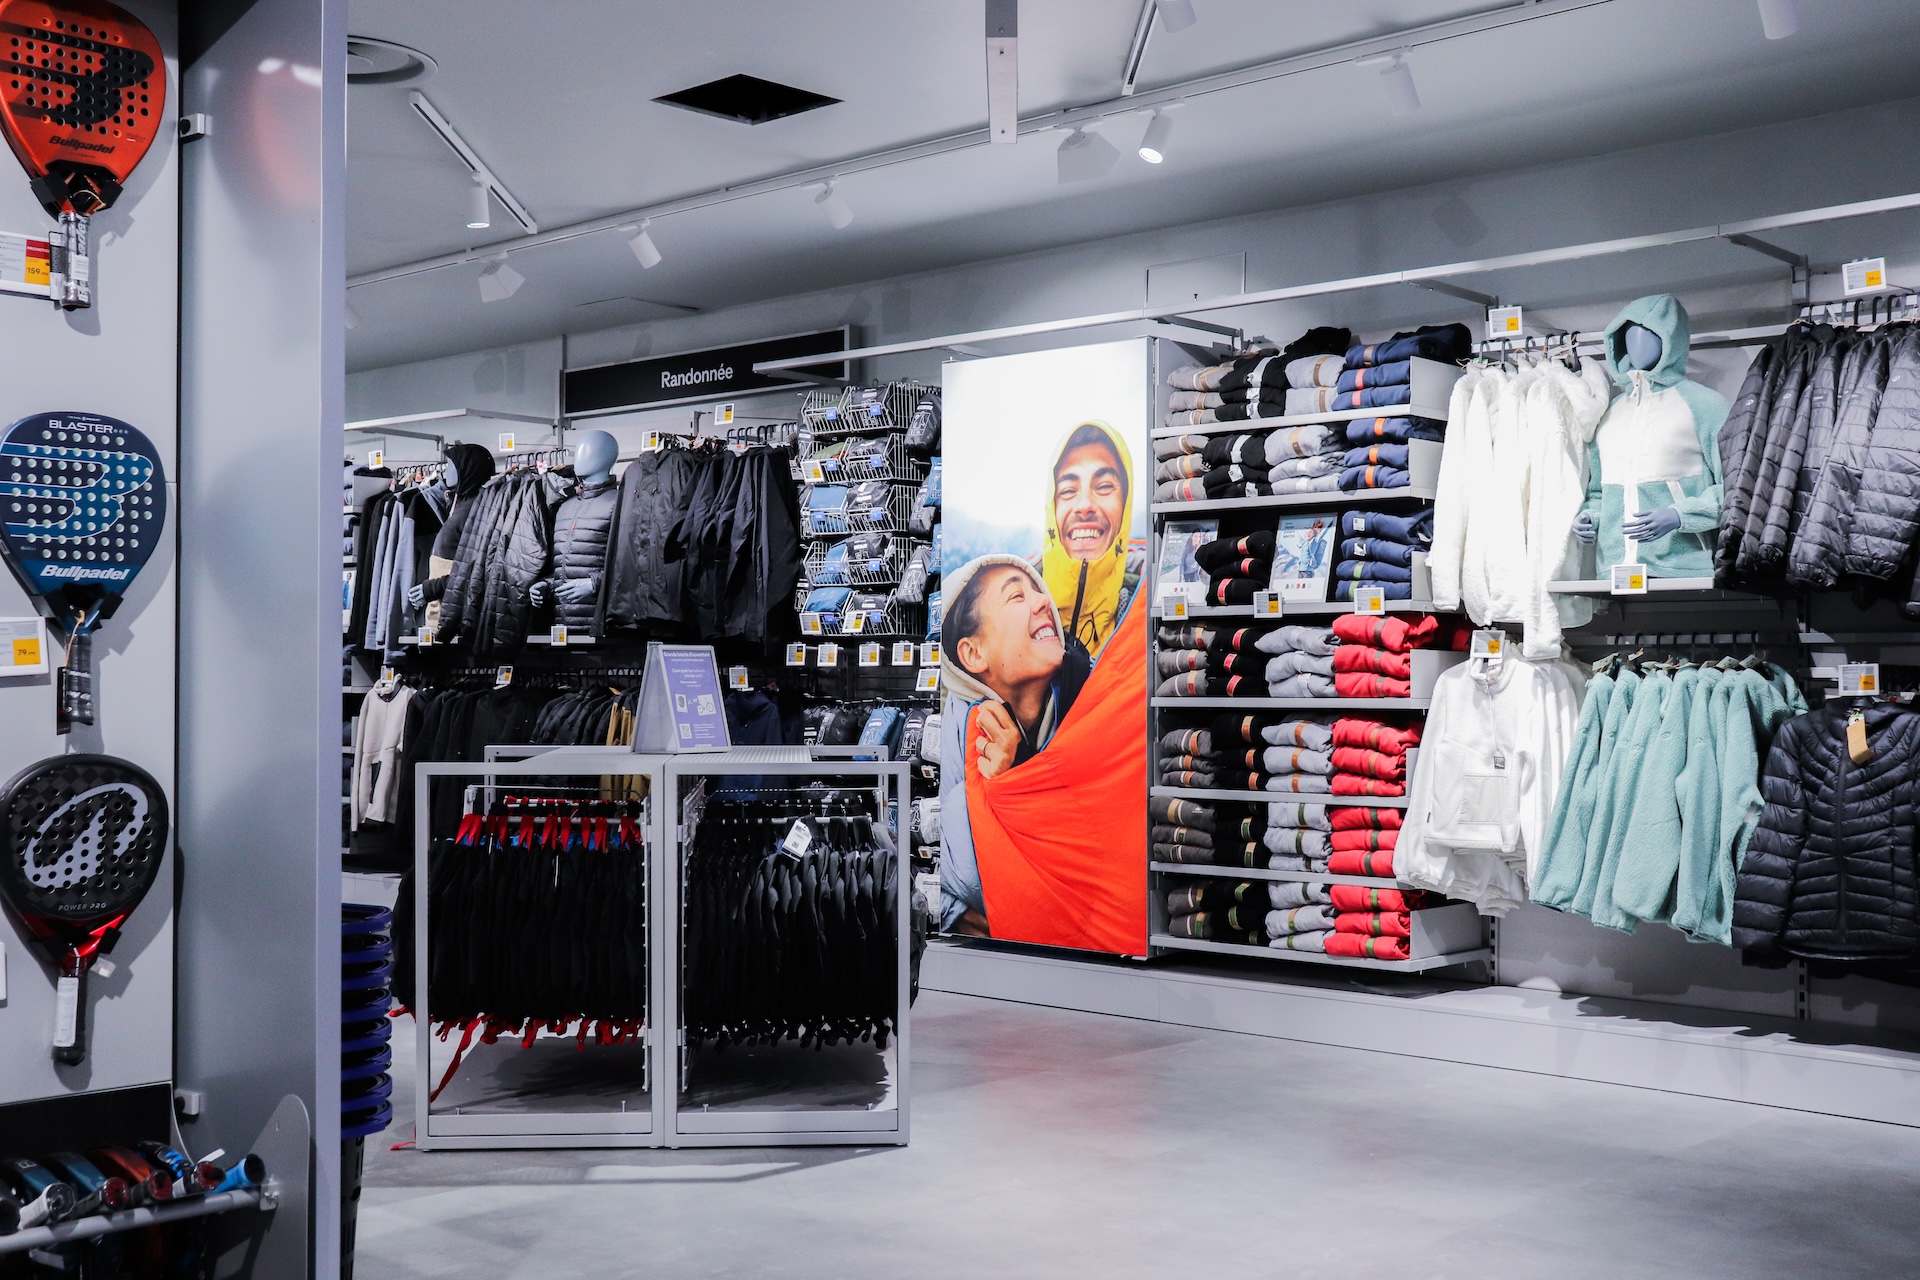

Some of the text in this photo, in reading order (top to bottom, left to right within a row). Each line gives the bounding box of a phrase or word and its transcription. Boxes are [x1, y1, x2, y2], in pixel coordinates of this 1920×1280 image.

[49, 135, 115, 154] Bullpadel
[26, 246, 50, 254] PROMOTIO
[27, 267, 41, 275] 159
[661, 363, 734, 388] Randonnée
[49, 419, 114, 434] BLASTER
[40, 564, 131, 581] Bullpadel
[58, 903, 88, 911] POWER
